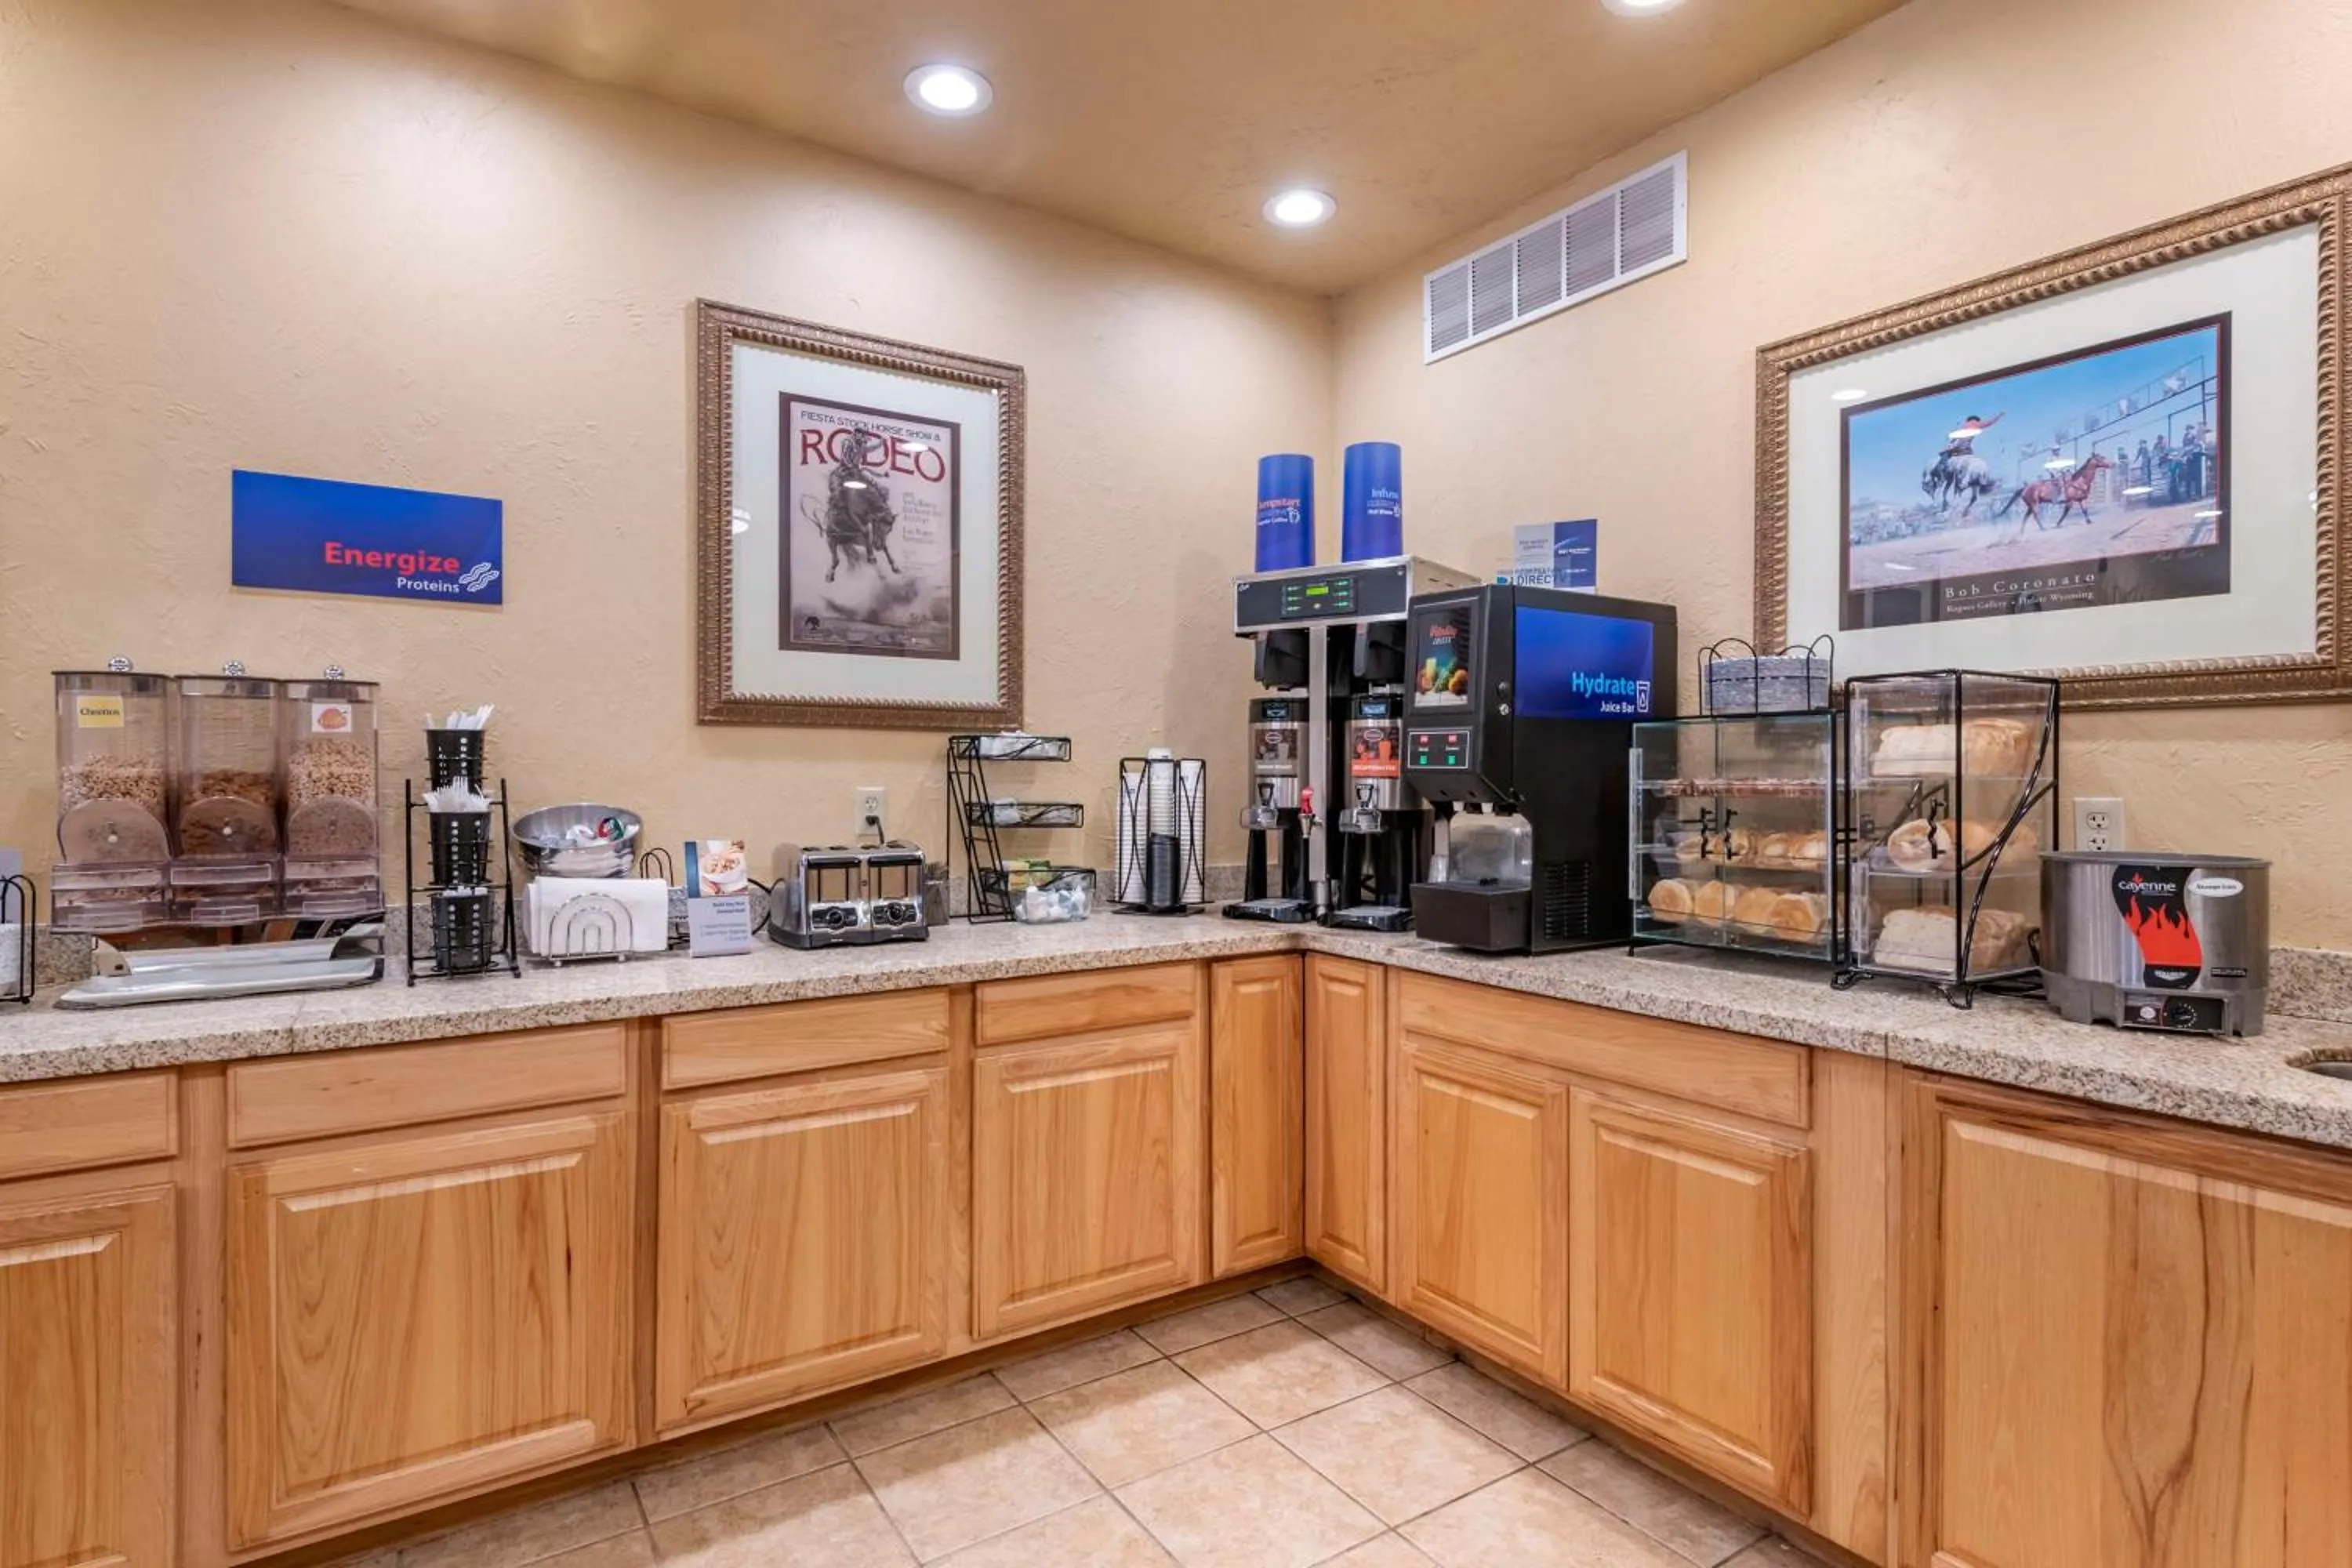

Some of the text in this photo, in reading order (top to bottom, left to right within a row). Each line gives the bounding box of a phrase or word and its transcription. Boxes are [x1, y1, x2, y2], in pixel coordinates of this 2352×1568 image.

[800, 411, 836, 423] FIESTA
[871, 423, 904, 435] HORSE
[906, 428, 931, 441] SHOW
[800, 428, 946, 482] RODEO
[325, 541, 460, 576] Energize
[397, 576, 460, 594] Proteins
[1945, 584, 1980, 598] Bob
[1572, 672, 1635, 699] Hydrate
[1600, 700, 1635, 713] Juice Bar
